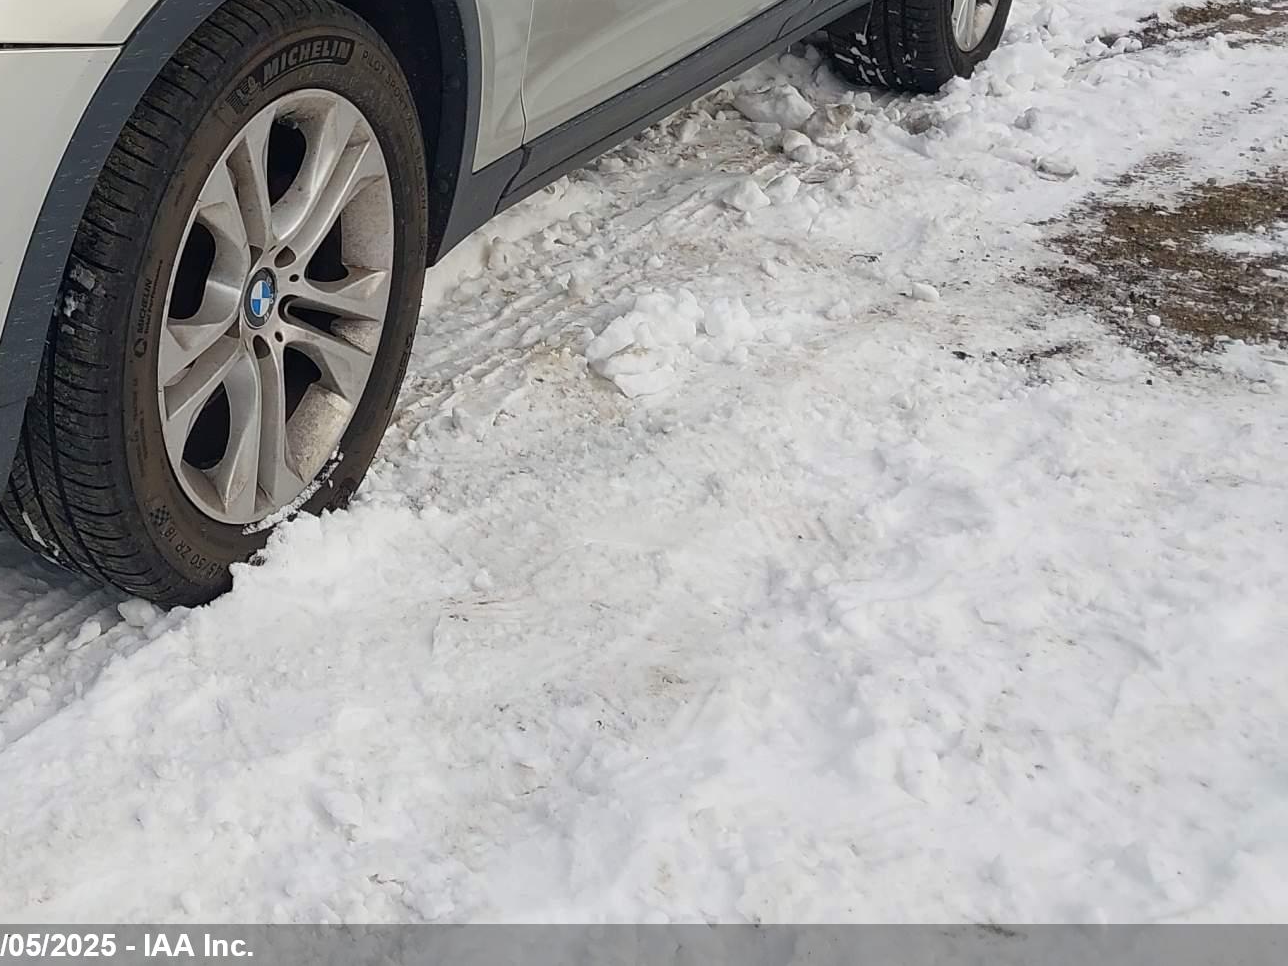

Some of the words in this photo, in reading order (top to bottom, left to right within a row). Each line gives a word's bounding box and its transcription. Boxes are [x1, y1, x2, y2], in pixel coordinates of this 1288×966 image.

[263, 39, 351, 83] MICHELIN
[362, 49, 386, 74] PILOT
[136, 277, 153, 334] MICHELIN
